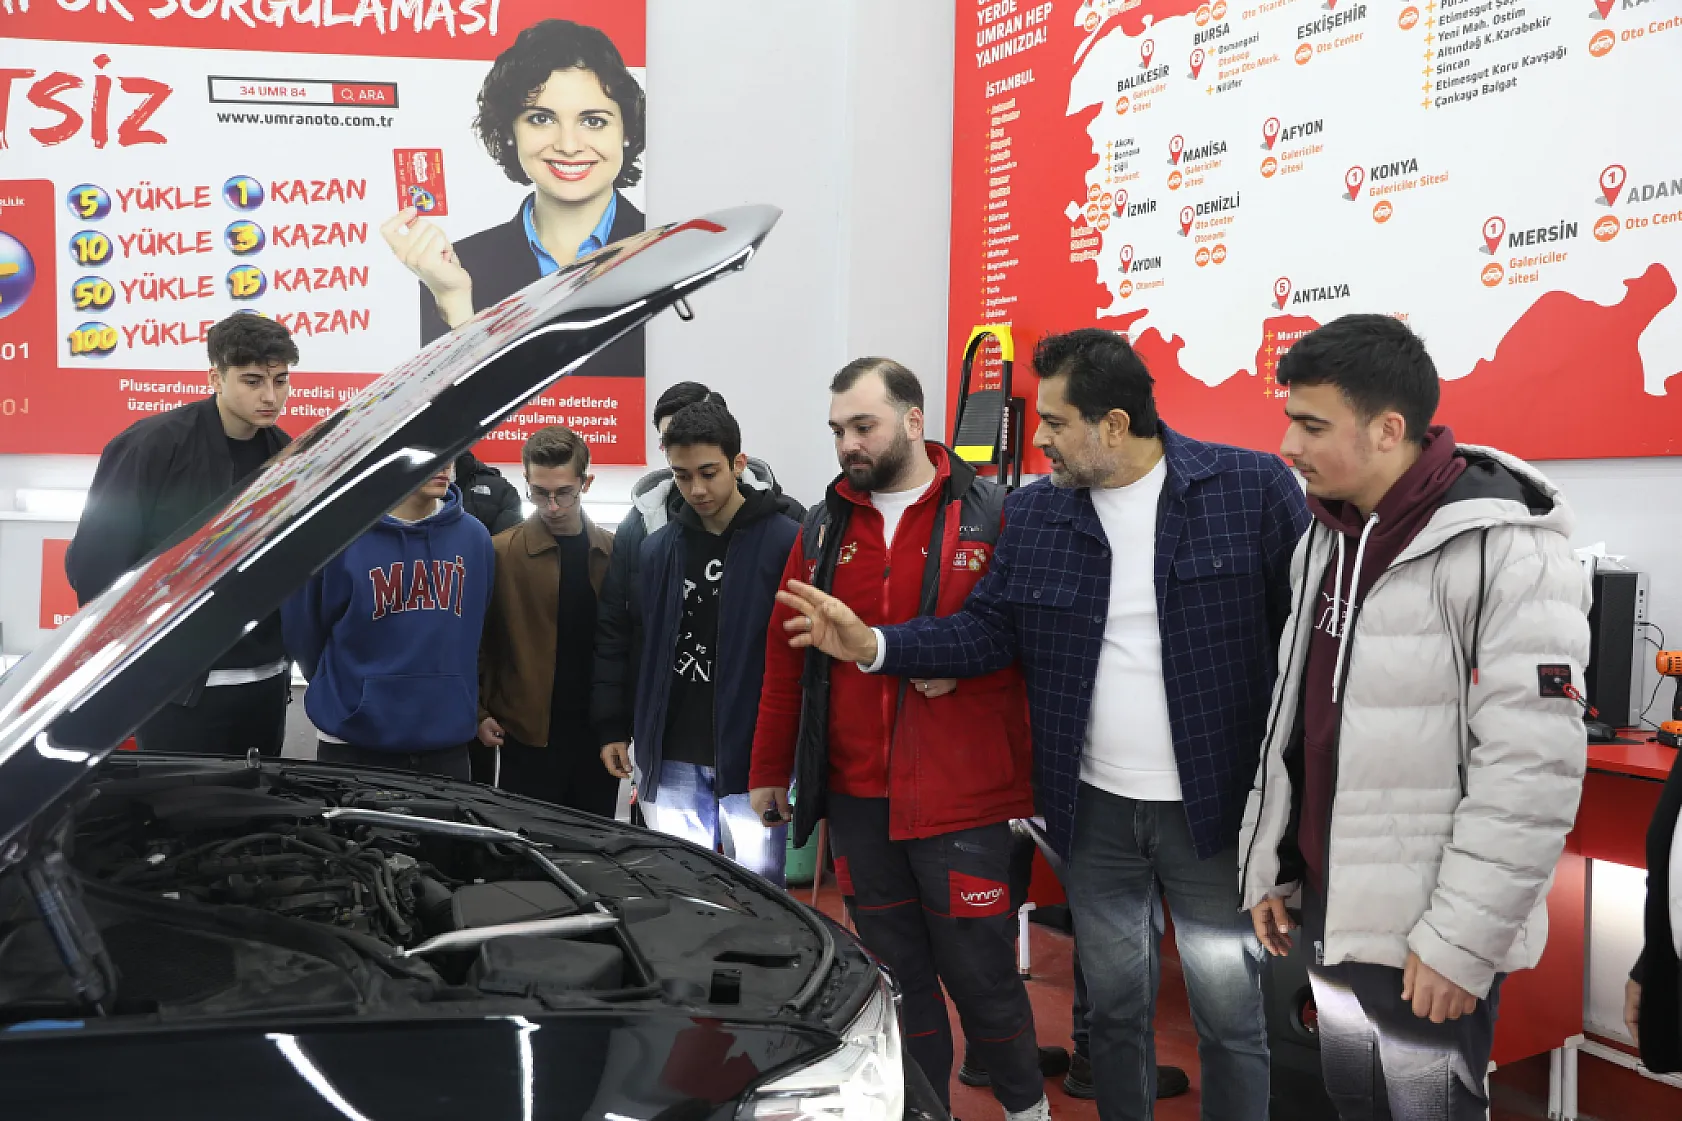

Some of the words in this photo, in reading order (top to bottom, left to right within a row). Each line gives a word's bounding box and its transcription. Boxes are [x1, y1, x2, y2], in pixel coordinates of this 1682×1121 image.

[977, 0, 1018, 26] YERDE
[1026, 1, 1053, 28] HEP
[1438, 26, 1460, 42] Yeni
[1493, 8, 1526, 26] Ostim
[1194, 22, 1231, 46] BURSA
[1621, 28, 1645, 42] Oto
[1648, 16, 1682, 34] Cent
[1436, 57, 1471, 75] Sincan
[240, 86, 255, 97] 34
[258, 86, 287, 98] UMR
[291, 87, 307, 98] 84
[358, 89, 385, 101] ARA
[217, 111, 394, 128] www.umranoto.com.tr
[1281, 118, 1323, 142] AFYON
[1183, 140, 1228, 163] MANİSA
[1370, 157, 1419, 182] KONYA
[80, 189, 99, 220] 5
[117, 181, 212, 212] YÜKLE
[236, 180, 250, 208] 1
[271, 178, 367, 204] KAZAN
[1127, 198, 1157, 218] İZMİR
[1196, 190, 1240, 217] DENİZLİ
[1508, 219, 1578, 249] MERSİN
[1625, 217, 1649, 230] Oto
[77, 236, 109, 267] 10
[118, 227, 214, 258] YÜKLE
[230, 225, 259, 256] 3
[273, 221, 369, 249] KAZAN
[73, 280, 114, 311] 50
[120, 272, 215, 304] YÜKLE
[230, 268, 262, 299] 15
[274, 265, 370, 294] KAZAN
[1292, 283, 1351, 305] ANTALYA
[276, 308, 370, 337] KAZAN
[67, 326, 119, 357] 100
[122, 318, 214, 348] YÜKLE
[120, 378, 215, 395] Pluscardınıza
[289, 385, 335, 399] kredisi
[128, 397, 188, 413] üzerind
[558, 397, 619, 409] adetlerde
[568, 414, 617, 427] yaparak
[369, 555, 466, 620] MAVİ
